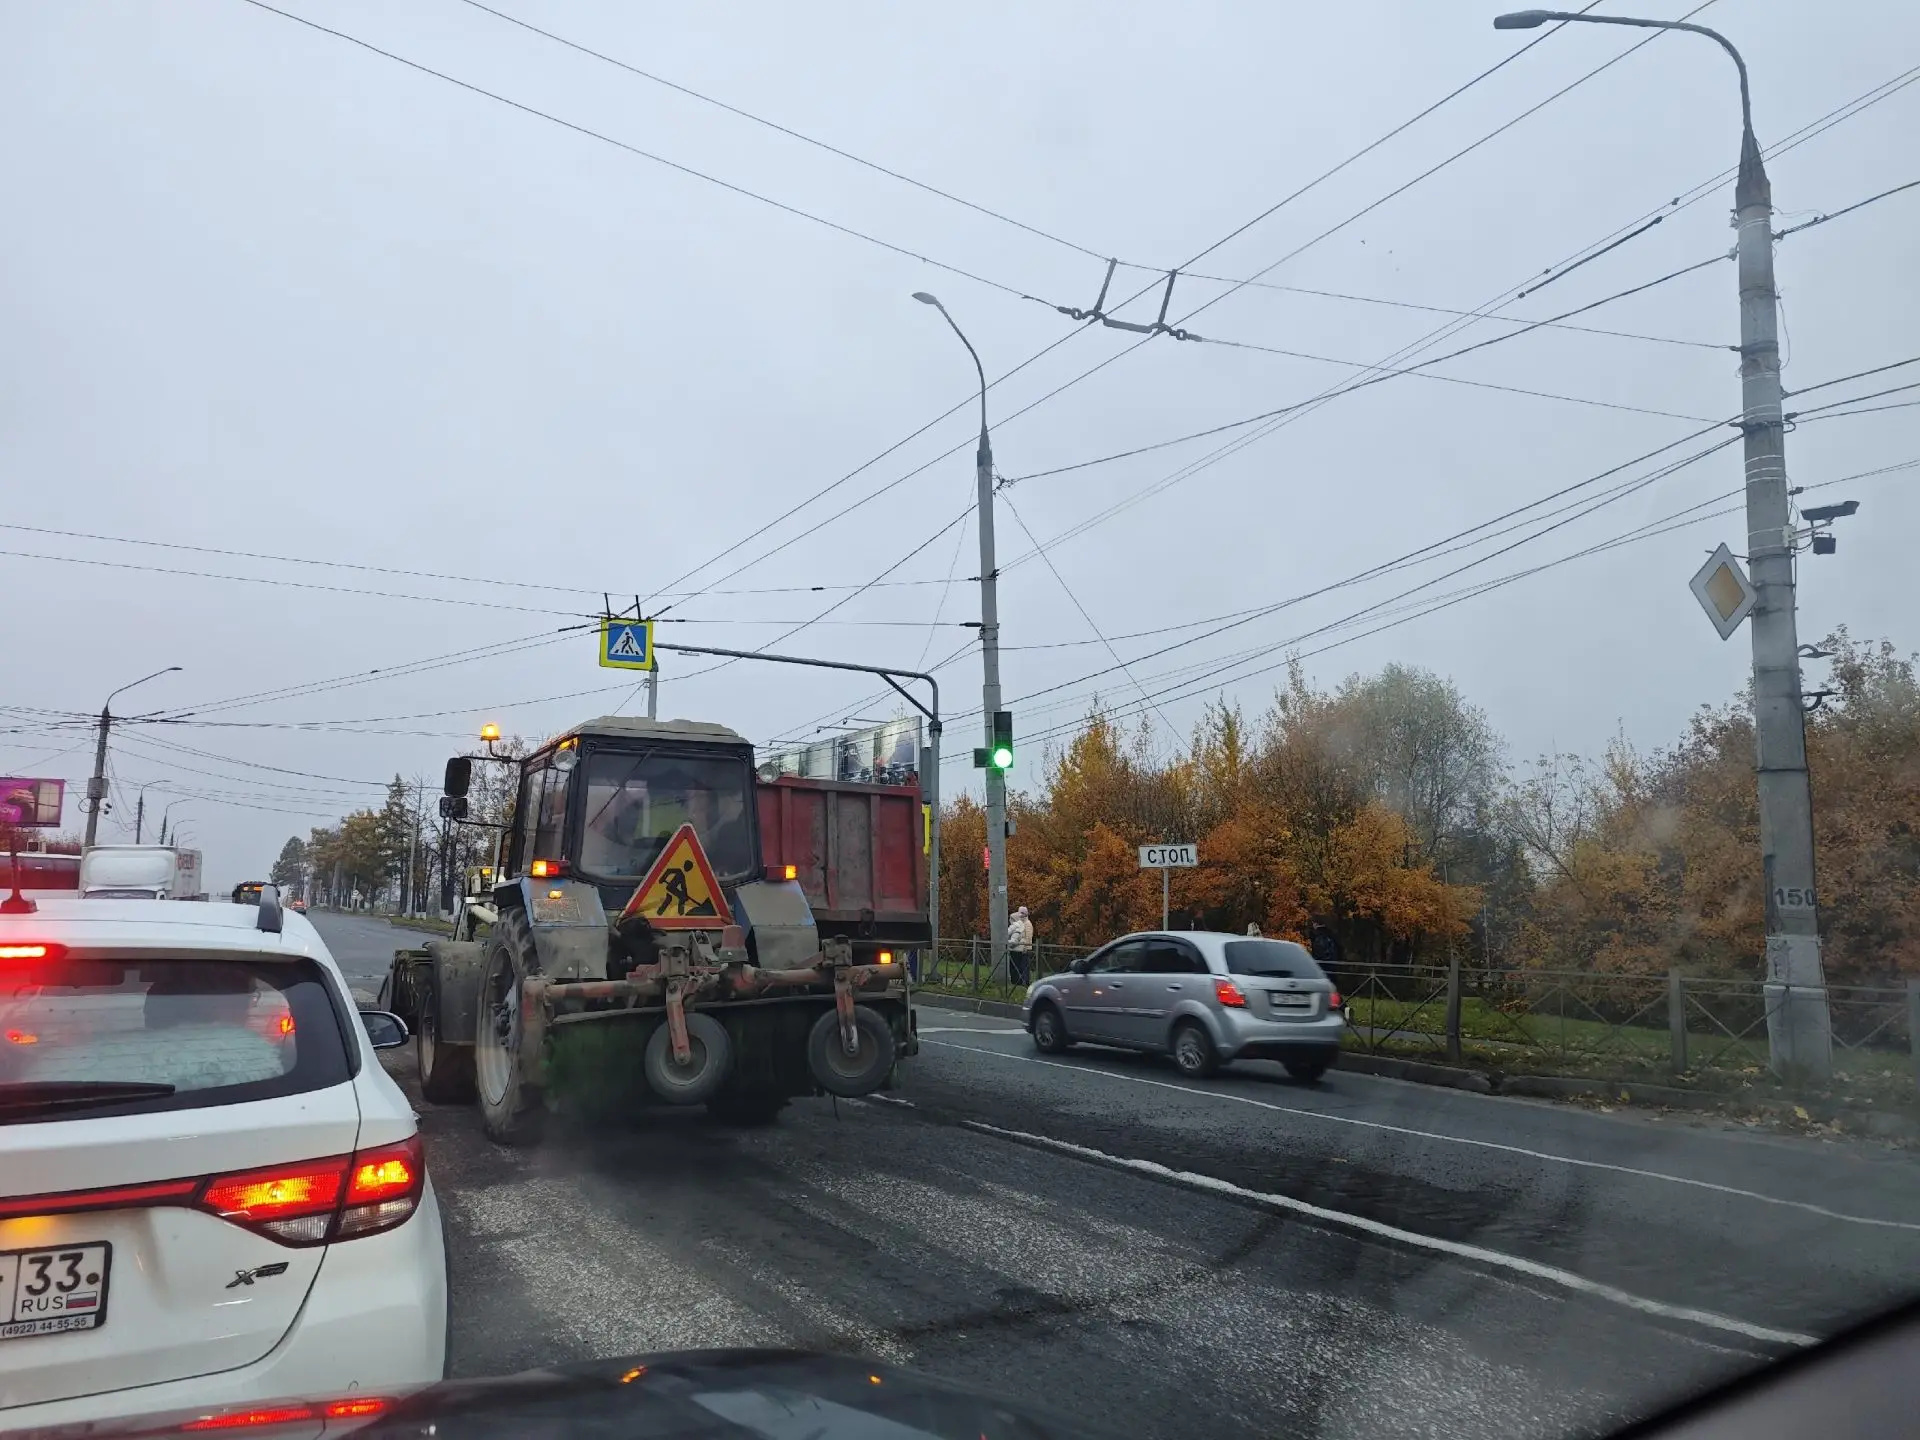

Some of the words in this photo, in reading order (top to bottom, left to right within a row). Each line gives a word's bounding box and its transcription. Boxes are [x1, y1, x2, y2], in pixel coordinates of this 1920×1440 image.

[1147, 848, 1190, 864] СТОП
[1775, 887, 1816, 907] 150
[25, 1252, 84, 1296] 33
[21, 1295, 64, 1313] RUS
[2, 1323, 37, 1337] (4922)
[40, 1317, 87, 1331] 44-55-55
